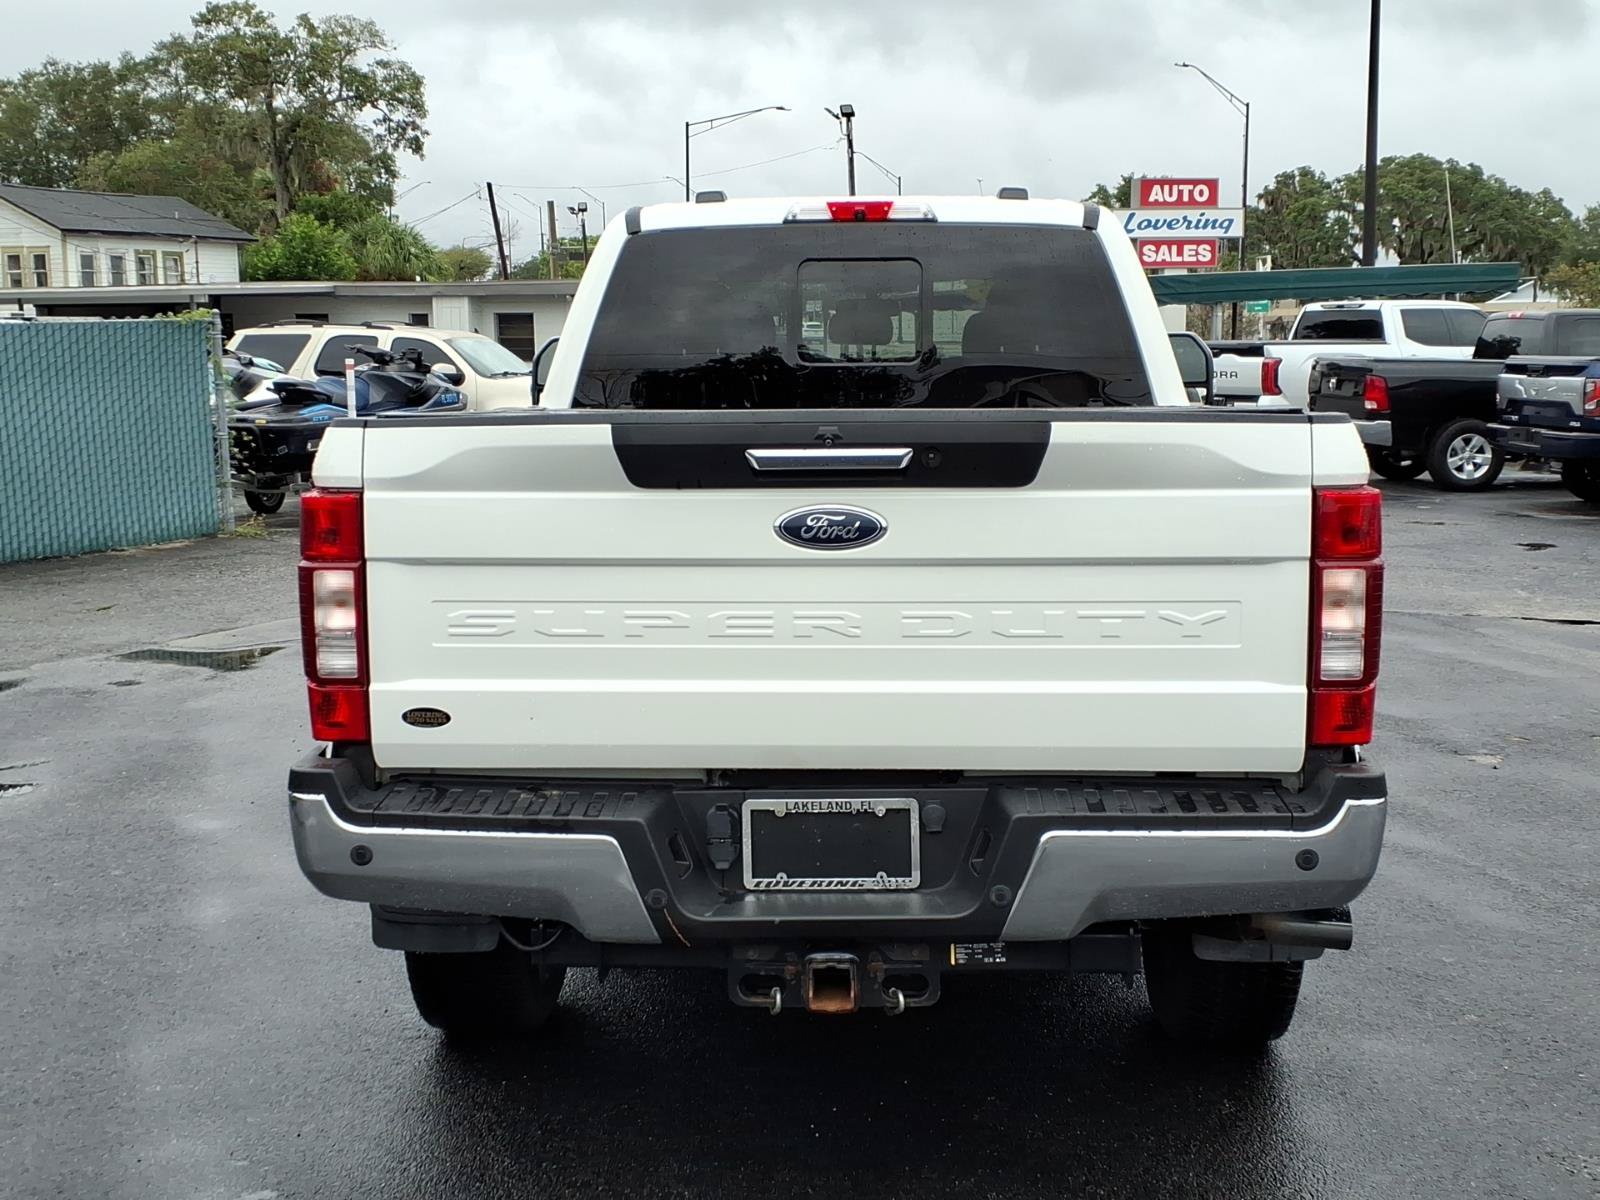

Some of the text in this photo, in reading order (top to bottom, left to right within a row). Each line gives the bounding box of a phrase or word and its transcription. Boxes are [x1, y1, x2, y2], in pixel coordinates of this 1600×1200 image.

[1148, 184, 1210, 202] AUTO
[1123, 212, 1235, 234] Lovering
[1142, 244, 1212, 262] SALES
[800, 513, 860, 539] Ford
[447, 609, 1228, 638] SUPER DUTY
[785, 801, 875, 814] LAKELAND, FL
[753, 879, 865, 888] LOVERING
